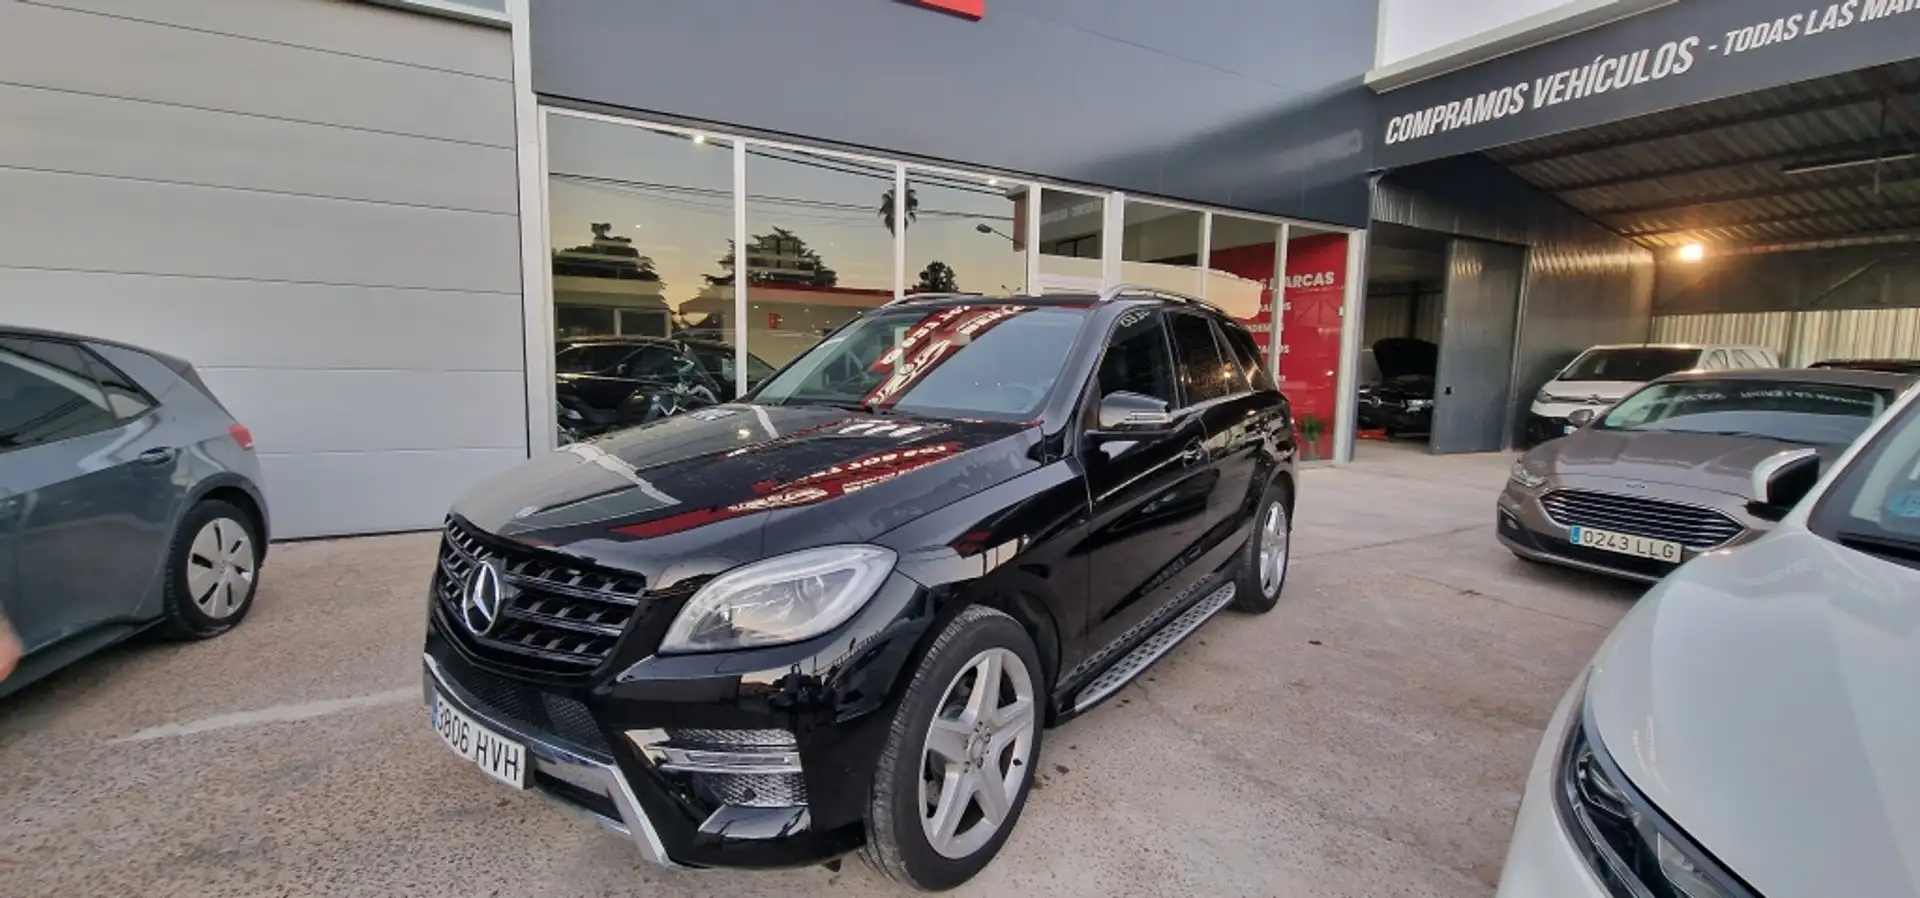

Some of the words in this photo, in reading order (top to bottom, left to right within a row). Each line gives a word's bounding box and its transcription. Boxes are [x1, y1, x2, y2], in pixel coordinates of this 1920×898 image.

[1385, 82, 1530, 145] COMPRAMOS
[1532, 35, 1700, 109] VEHÍCULOS
[1723, 13, 1804, 56] TODAS
[1804, 0, 1858, 36] LAS
[1584, 530, 1629, 550] 0243
[1636, 540, 1675, 559] LLG
[437, 700, 470, 754] 3806
[476, 731, 519, 782] HVH
